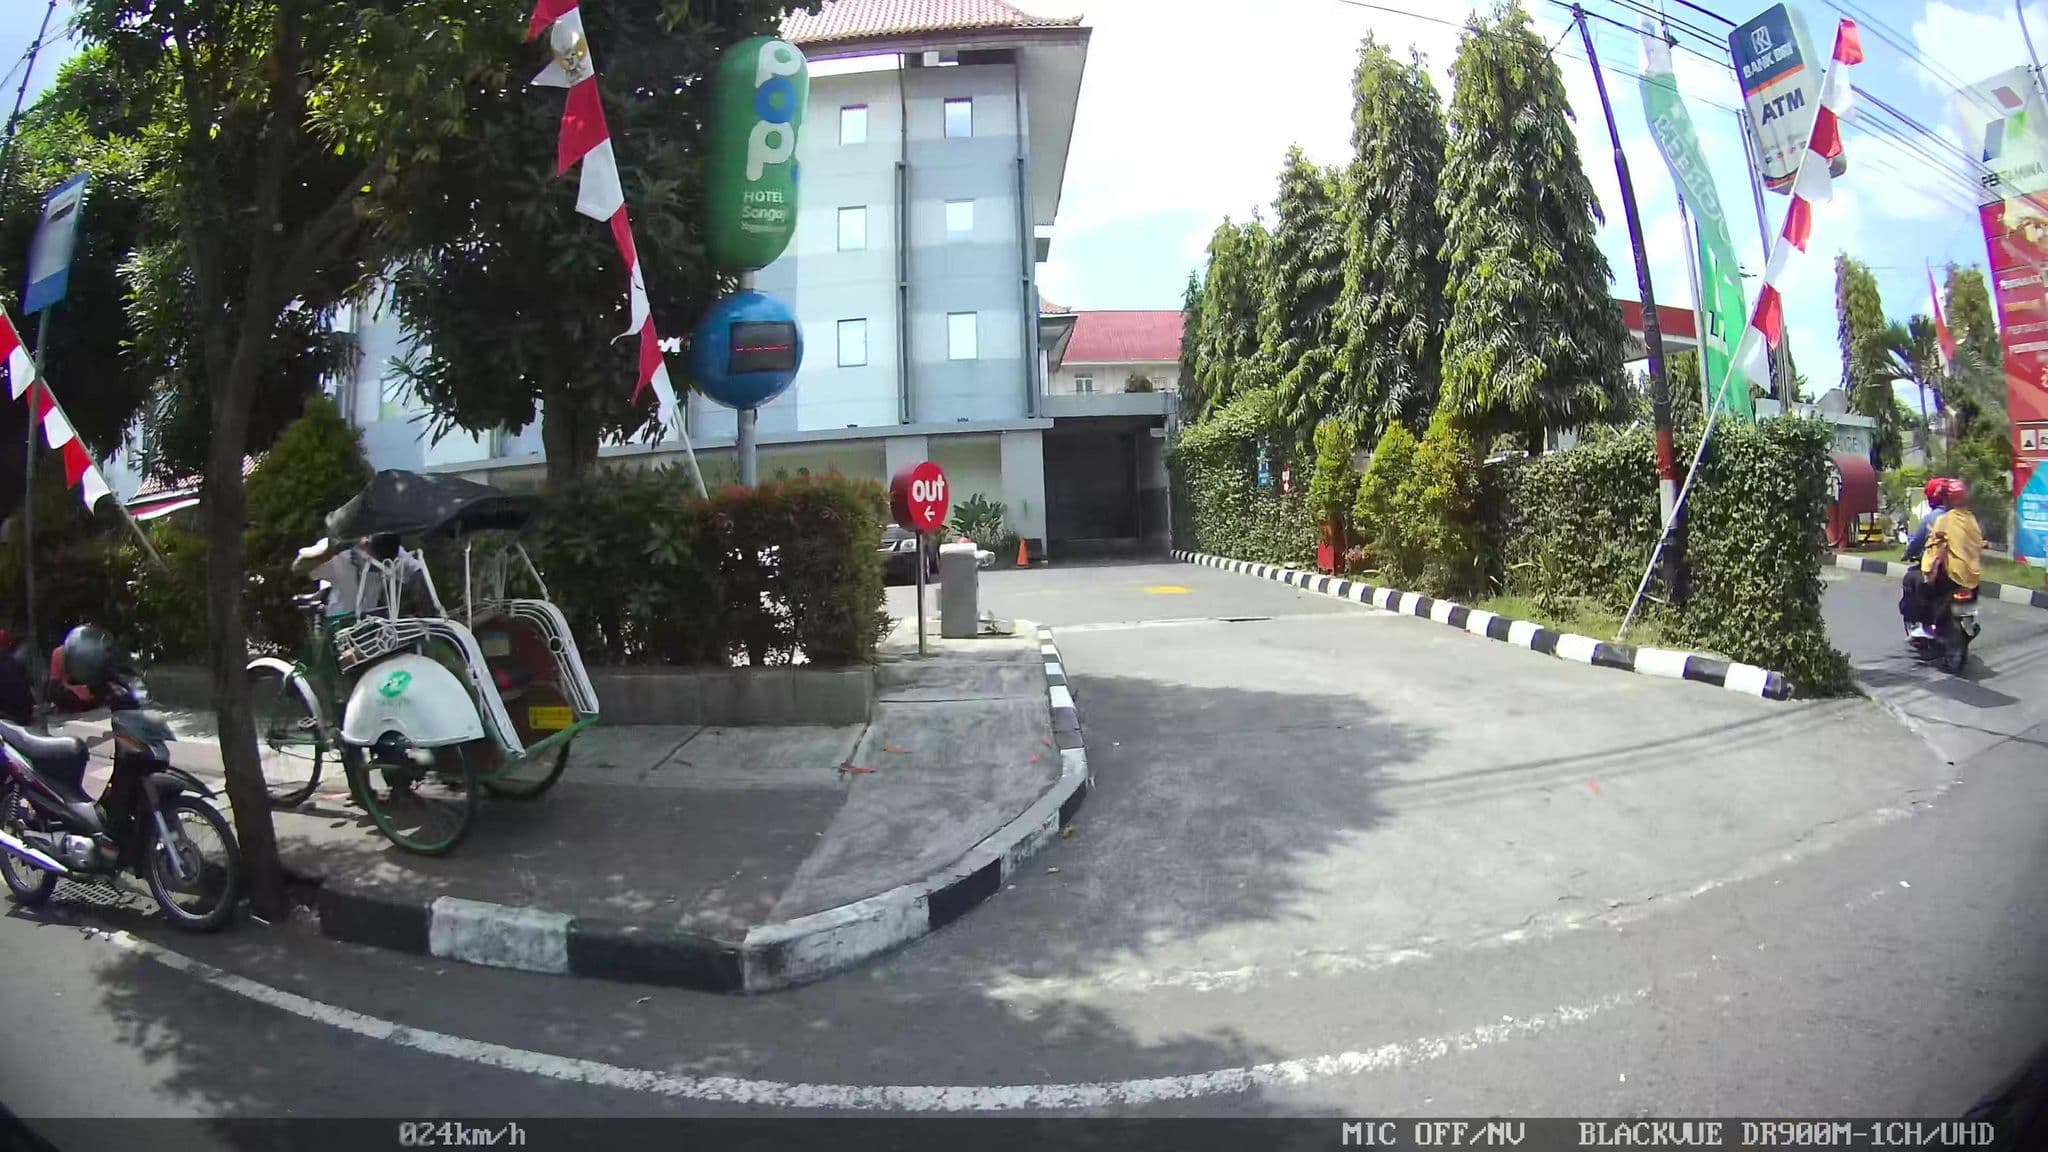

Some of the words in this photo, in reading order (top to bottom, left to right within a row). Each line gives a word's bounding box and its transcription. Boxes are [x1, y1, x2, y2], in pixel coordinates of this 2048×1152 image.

[1742, 51, 1775, 79] BANK
[1762, 87, 1806, 126] ATM
[743, 190, 785, 204] HOTEL
[912, 473, 945, 503] out
